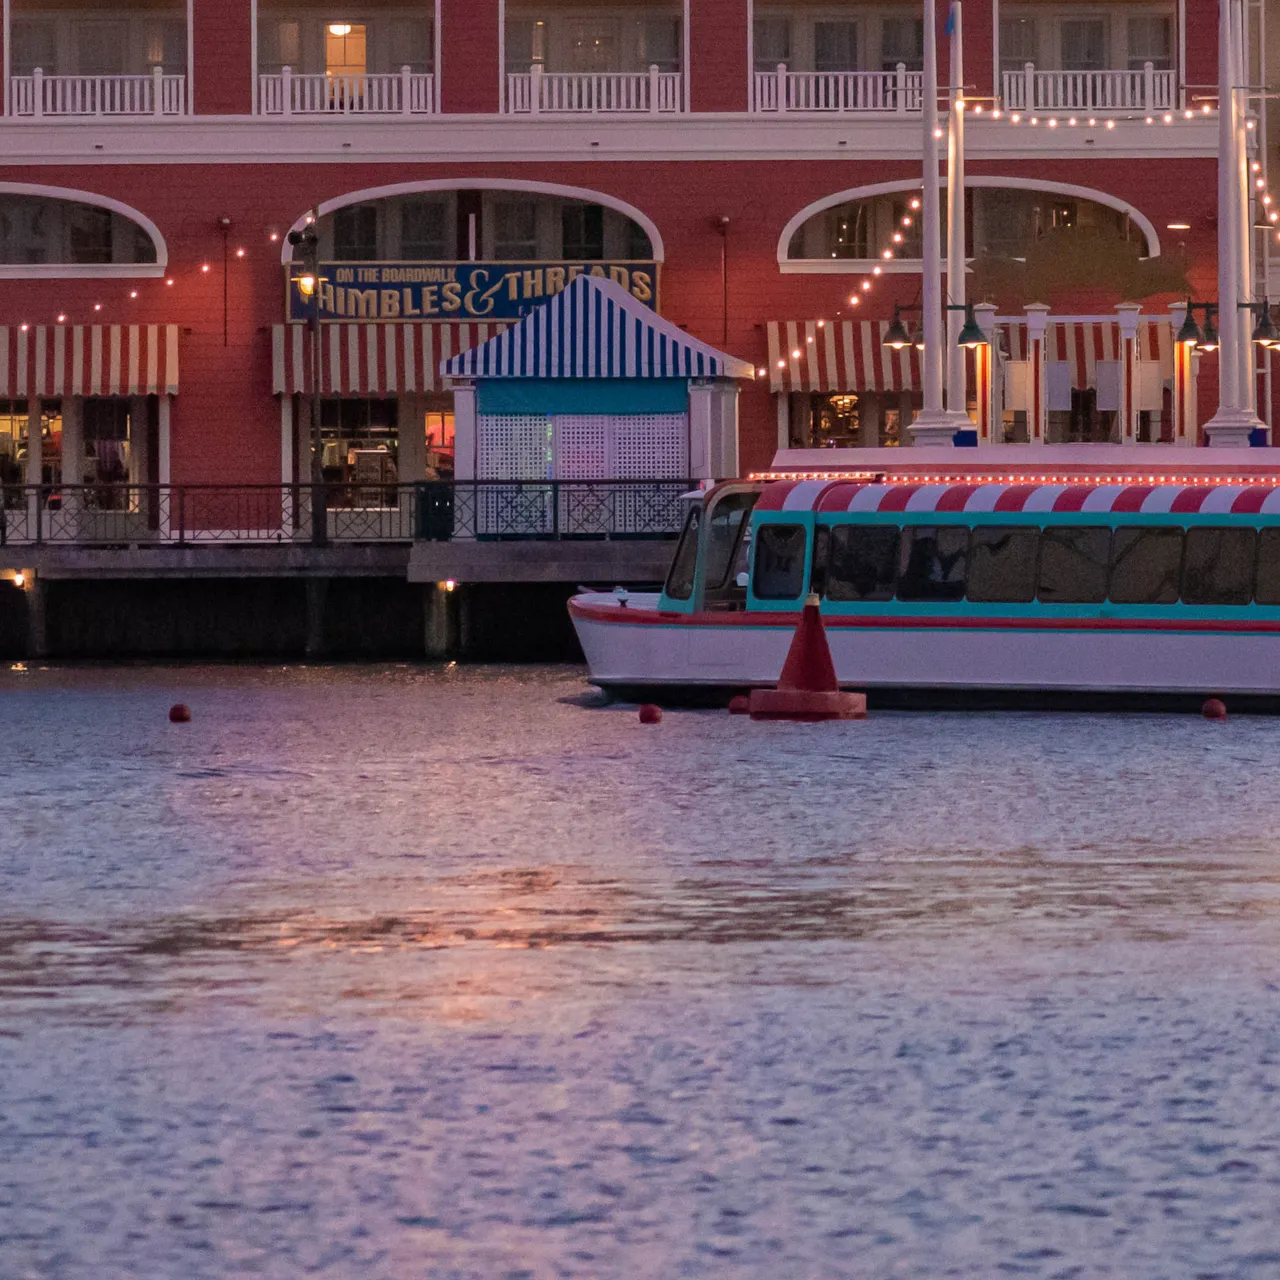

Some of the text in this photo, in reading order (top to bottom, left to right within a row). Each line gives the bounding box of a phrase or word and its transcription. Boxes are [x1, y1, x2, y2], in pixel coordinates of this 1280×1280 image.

[336, 267, 456, 283] ON THE BOARDWALK
[299, 282, 462, 318] HIMBLES
[463, 269, 505, 315] &
